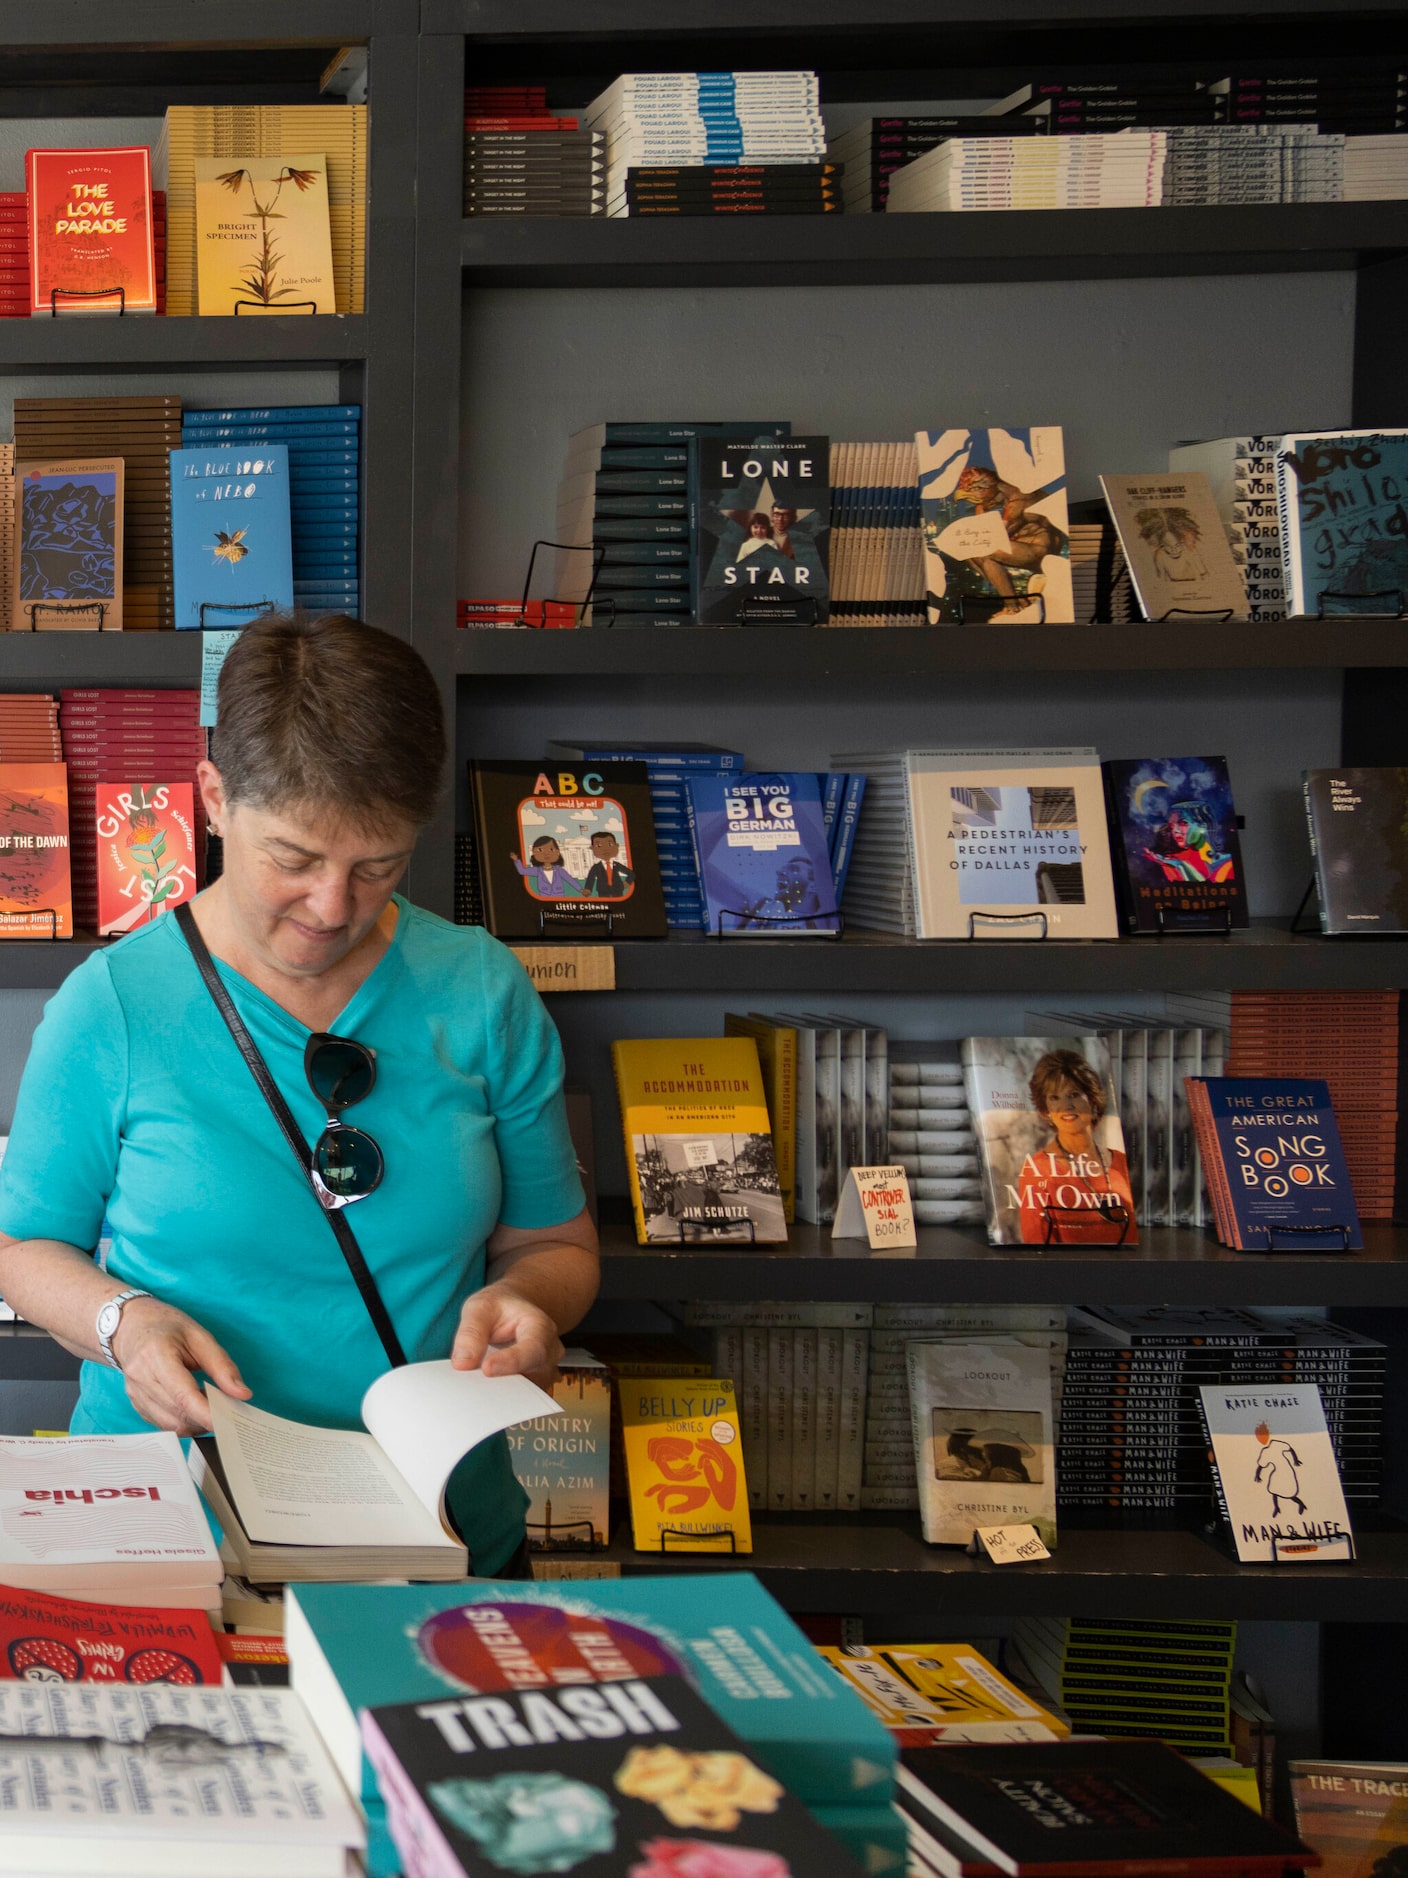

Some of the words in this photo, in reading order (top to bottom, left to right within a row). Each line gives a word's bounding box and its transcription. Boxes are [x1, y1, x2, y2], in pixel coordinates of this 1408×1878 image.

[73, 184, 108, 199] THE
[67, 201, 115, 217] LOVE
[57, 217, 127, 236] PARADE
[721, 460, 813, 478] LONE
[724, 567, 810, 584] STAR
[724, 786, 730, 797] I
[731, 786, 757, 797] SEE
[760, 785, 790, 797] YOU
[96, 786, 169, 838] GIRLS
[726, 797, 793, 819] BIG
[729, 818, 795, 831] GERMAN
[14, 836, 34, 848] THE
[37, 835, 68, 848] DAWN
[947, 831, 955, 839] A
[962, 830, 1069, 840] PEDESTRIAN'S
[959, 845, 1016, 855] RECENT
[1023, 845, 1088, 855] HISTORY
[950, 861, 969, 870] OF
[975, 861, 1030, 870] DALLAS
[683, 1064, 705, 1076] THE
[644, 1079, 750, 1093] ACCOMMODATION
[1226, 1096, 1258, 1108] THE
[1261, 1096, 1314, 1108] GREAT
[1232, 1114, 1320, 1126] AMERICAN
[1235, 1135, 1326, 1169] SONG
[1019, 1156, 1044, 1177] A
[1050, 1153, 1100, 1177] Life
[858, 1171, 877, 1181] DEEP
[1244, 1164, 1335, 1197] BOOK
[1038, 1179, 1048, 1189] of
[862, 1189, 905, 1209] CONTROVER
[1006, 1185, 1050, 1216] My
[1055, 1185, 1121, 1209] Own
[877, 1208, 899, 1219] SIAL
[875, 1218, 910, 1236] BOOK?
[963, 1371, 1011, 1382] LOOKOUT
[639, 1395, 694, 1418] BELLY
[702, 1396, 727, 1417] UP
[1225, 1398, 1260, 1410] KATIE
[1266, 1397, 1299, 1409] CHASE
[24, 1486, 158, 1502] Ischia
[956, 1502, 1008, 1515] CHRISTINE
[1012, 1504, 1030, 1515] BYL
[986, 1530, 1008, 1549] HOT
[417, 1684, 680, 1754] TRASH
